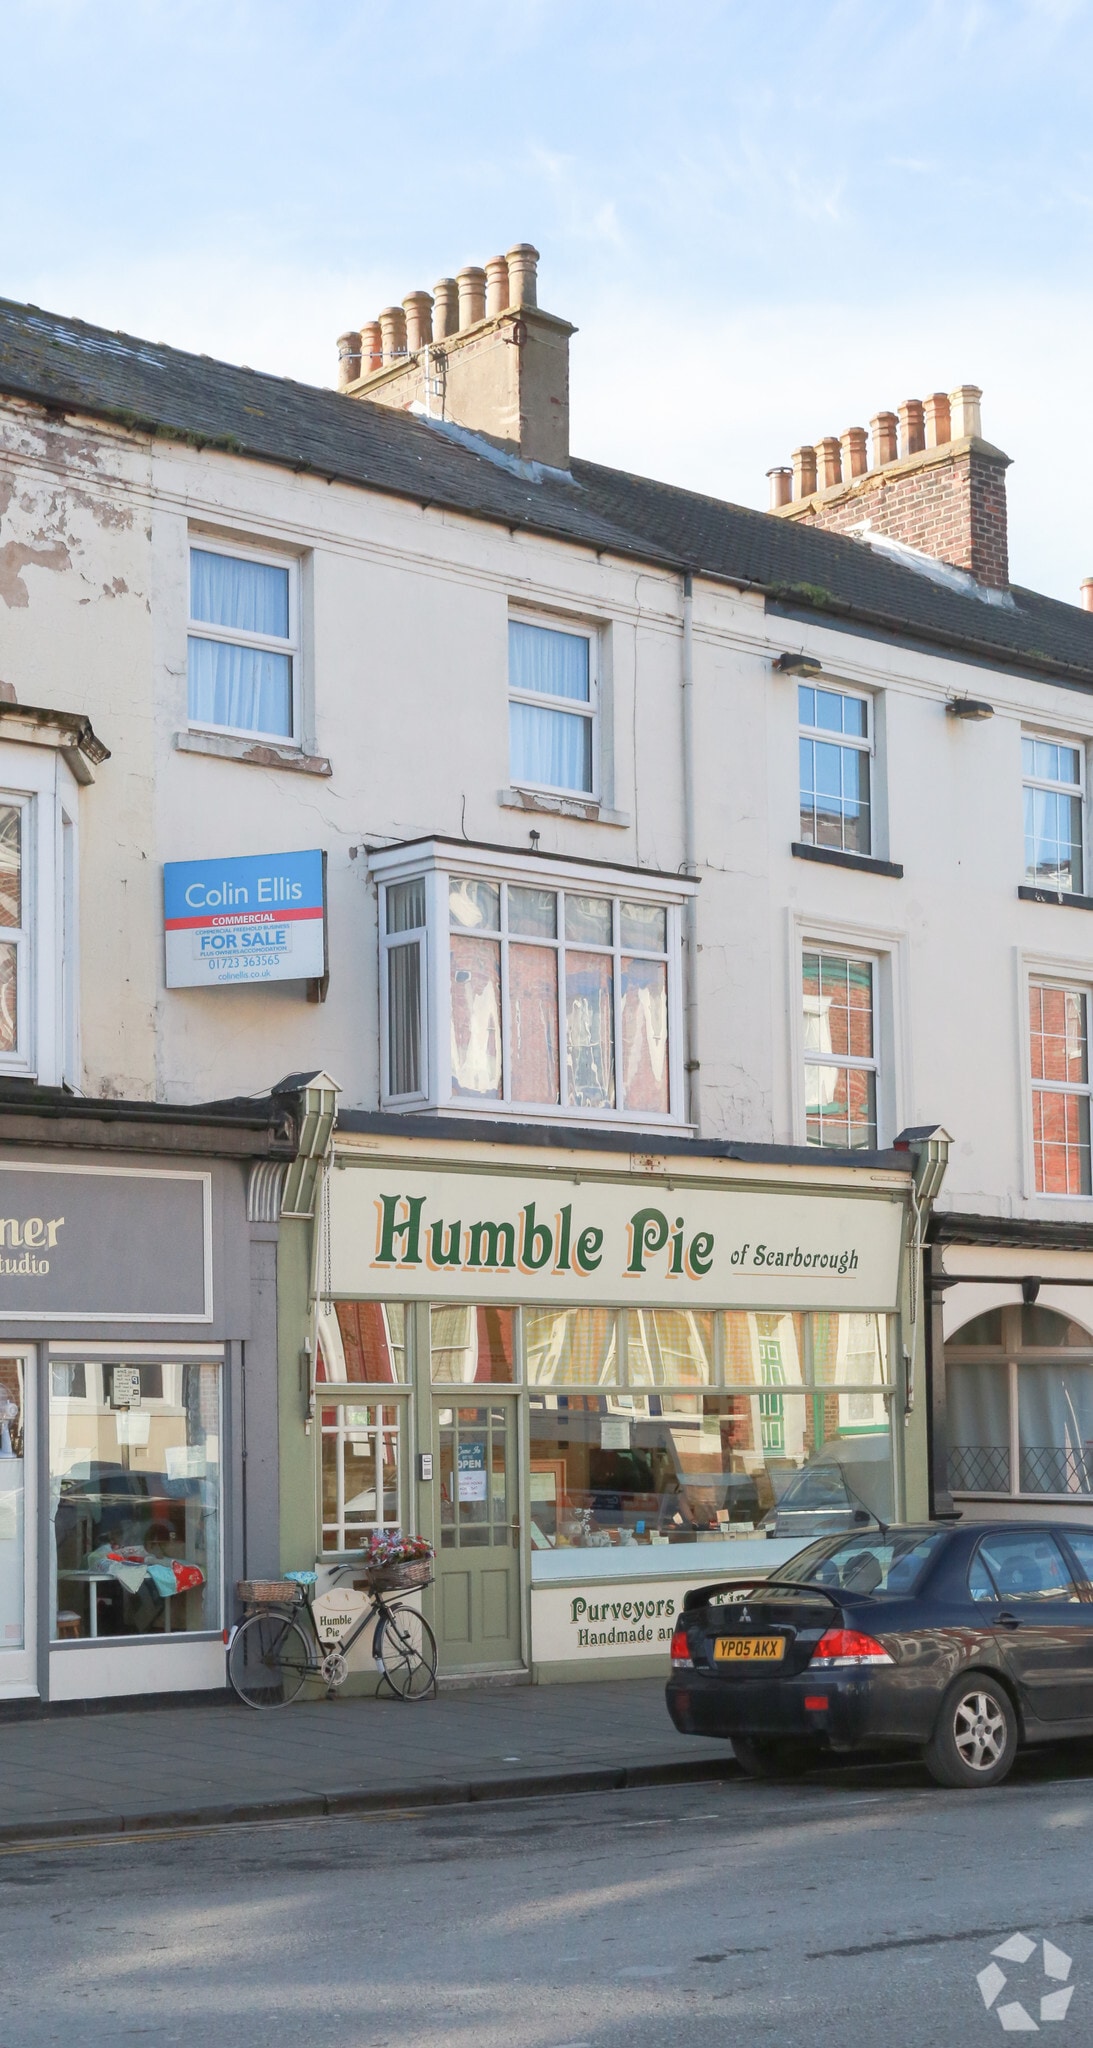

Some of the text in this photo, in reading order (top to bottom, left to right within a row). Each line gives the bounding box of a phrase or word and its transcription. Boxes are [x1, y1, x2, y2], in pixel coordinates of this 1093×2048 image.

[185, 877, 302, 908] Colin Ellis
[212, 913, 275, 926] COMMERCIAL
[195, 928, 231, 936] COMMERCIAL
[233, 925, 262, 933] FREEHOLD
[201, 930, 286, 950] FOR SALE
[208, 954, 280, 970] 01723 363565
[218, 969, 271, 982] colinellis.co.uk
[370, 1193, 715, 1281] Humble Pie
[730, 1243, 859, 1274] of Scarborough
[458, 1460, 481, 1468] OPEN
[571, 1596, 675, 1624] Purveyors
[320, 1615, 352, 1625] Humble
[326, 1627, 340, 1637] Pie
[578, 1624, 653, 1647] Handmade
[721, 1640, 778, 1656] YP05 AKX
